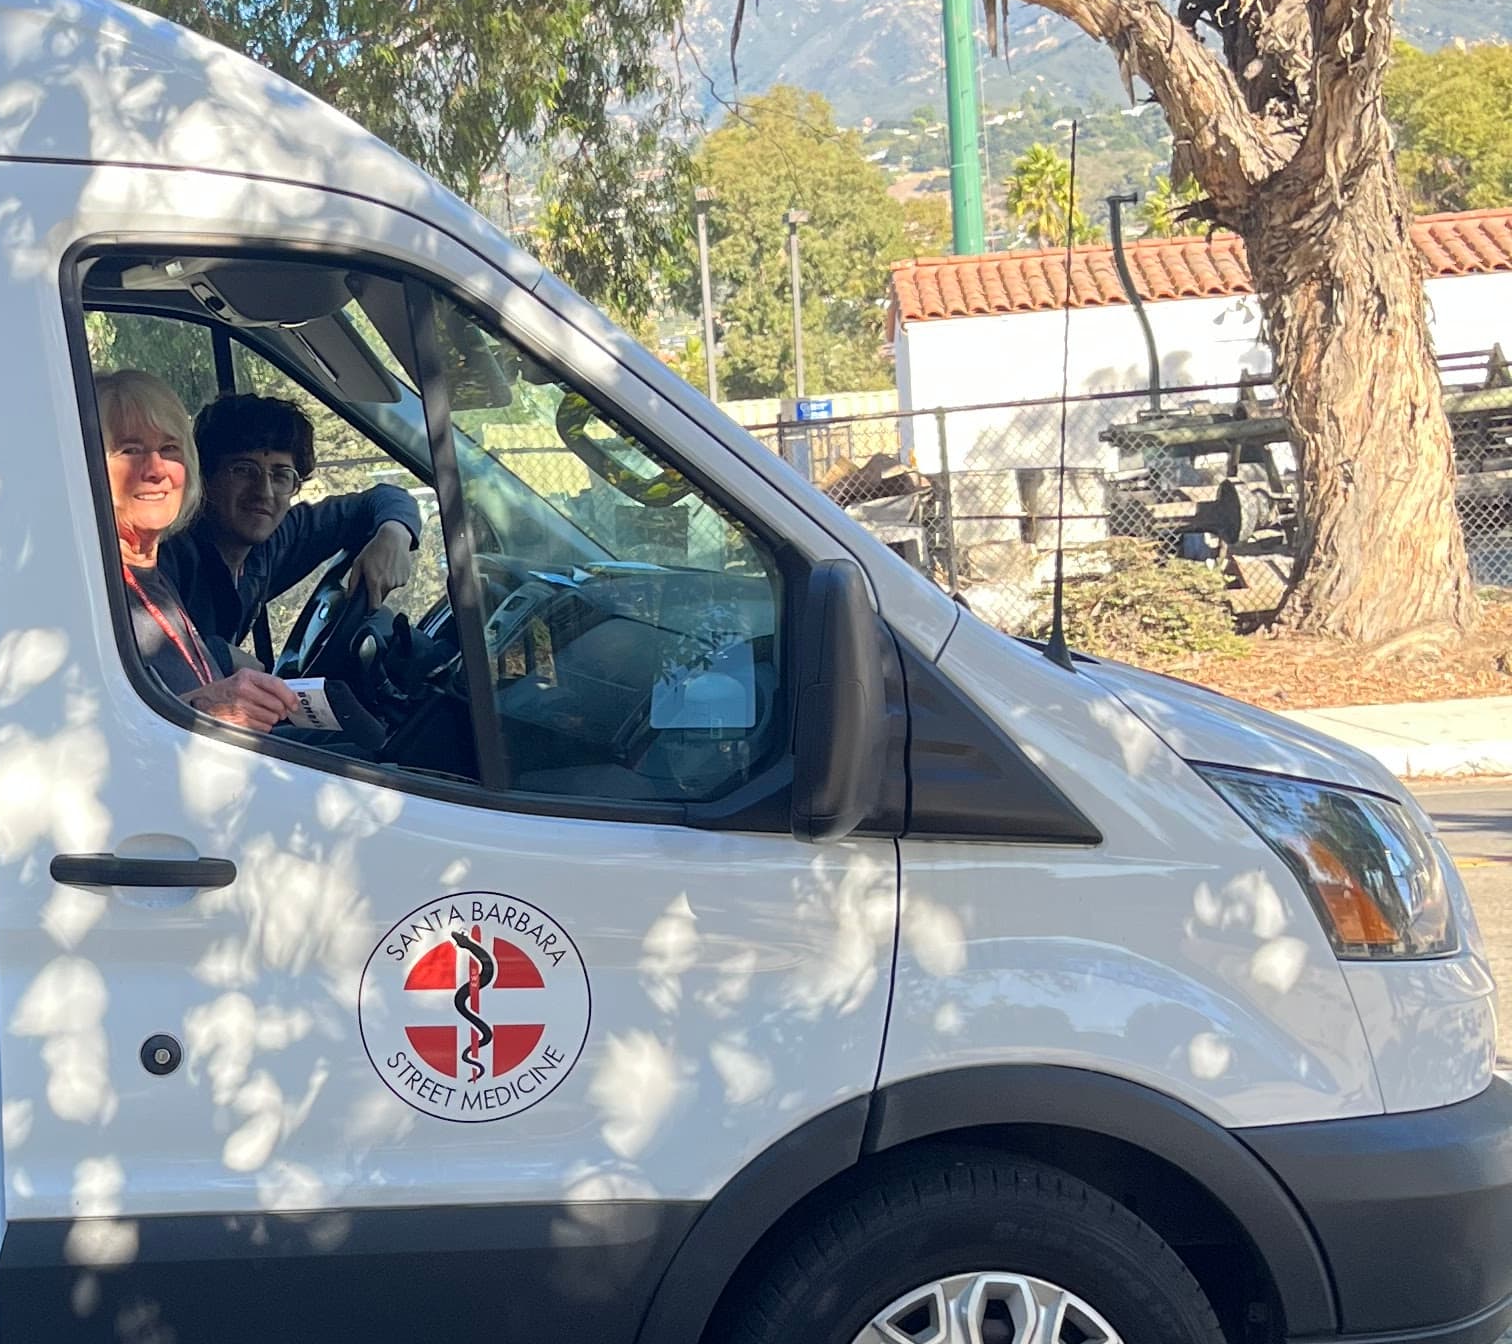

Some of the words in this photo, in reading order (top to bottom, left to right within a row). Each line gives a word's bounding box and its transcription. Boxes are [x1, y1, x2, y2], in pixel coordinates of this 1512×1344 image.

[386, 903, 466, 961] SANTA
[472, 901, 568, 967] BARBARA
[387, 1051, 457, 1107] STREET
[460, 1044, 565, 1110] MEDICINE
